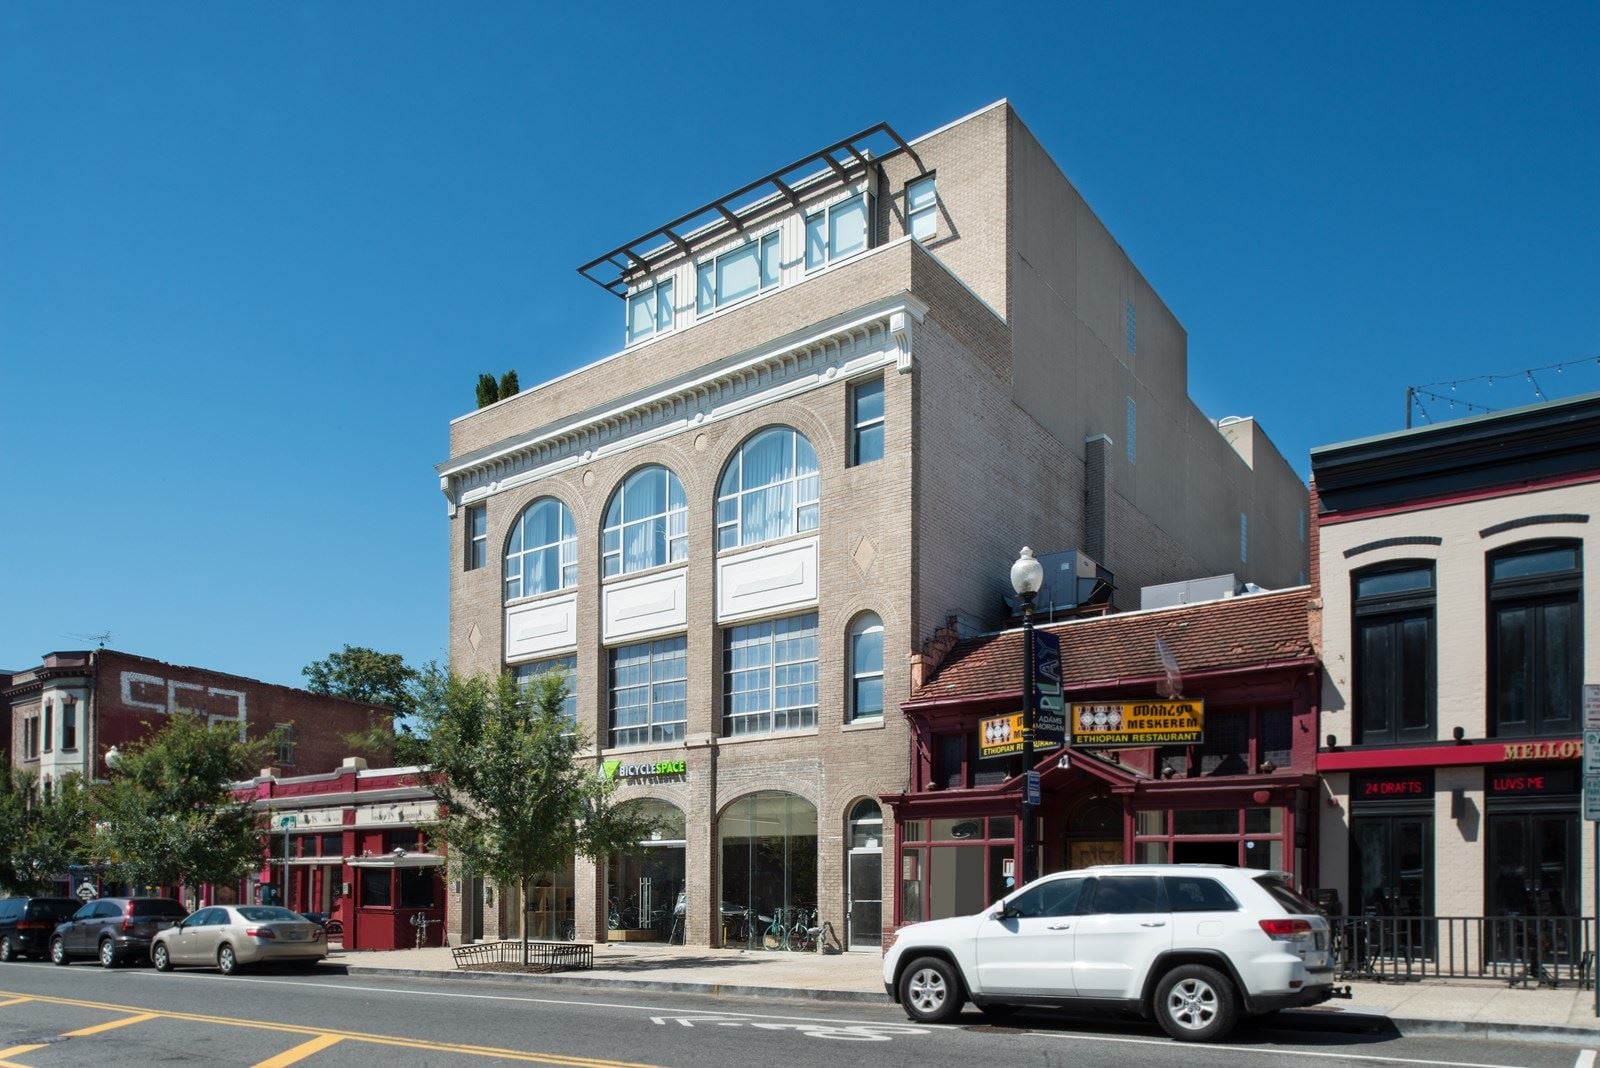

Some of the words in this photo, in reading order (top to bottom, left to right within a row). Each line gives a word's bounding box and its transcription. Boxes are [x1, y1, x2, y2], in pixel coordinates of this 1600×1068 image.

[1037, 636, 1061, 710] PLAY
[1038, 715, 1063, 725] ADAMS
[1127, 718, 1198, 729] MESKEREM
[1036, 723, 1065, 732] MORGAN
[1076, 734, 1129, 743] ETHIOPIAN
[1132, 732, 1198, 742] RESTAURANT
[983, 744, 1015, 756] ETHIOPIAN
[619, 761, 686, 777] BICYCLESPACE
[1365, 783, 1378, 794] 24
[1381, 781, 1423, 794] DRAFTS
[1494, 778, 1525, 790] LUVS
[1527, 777, 1544, 789] ME
